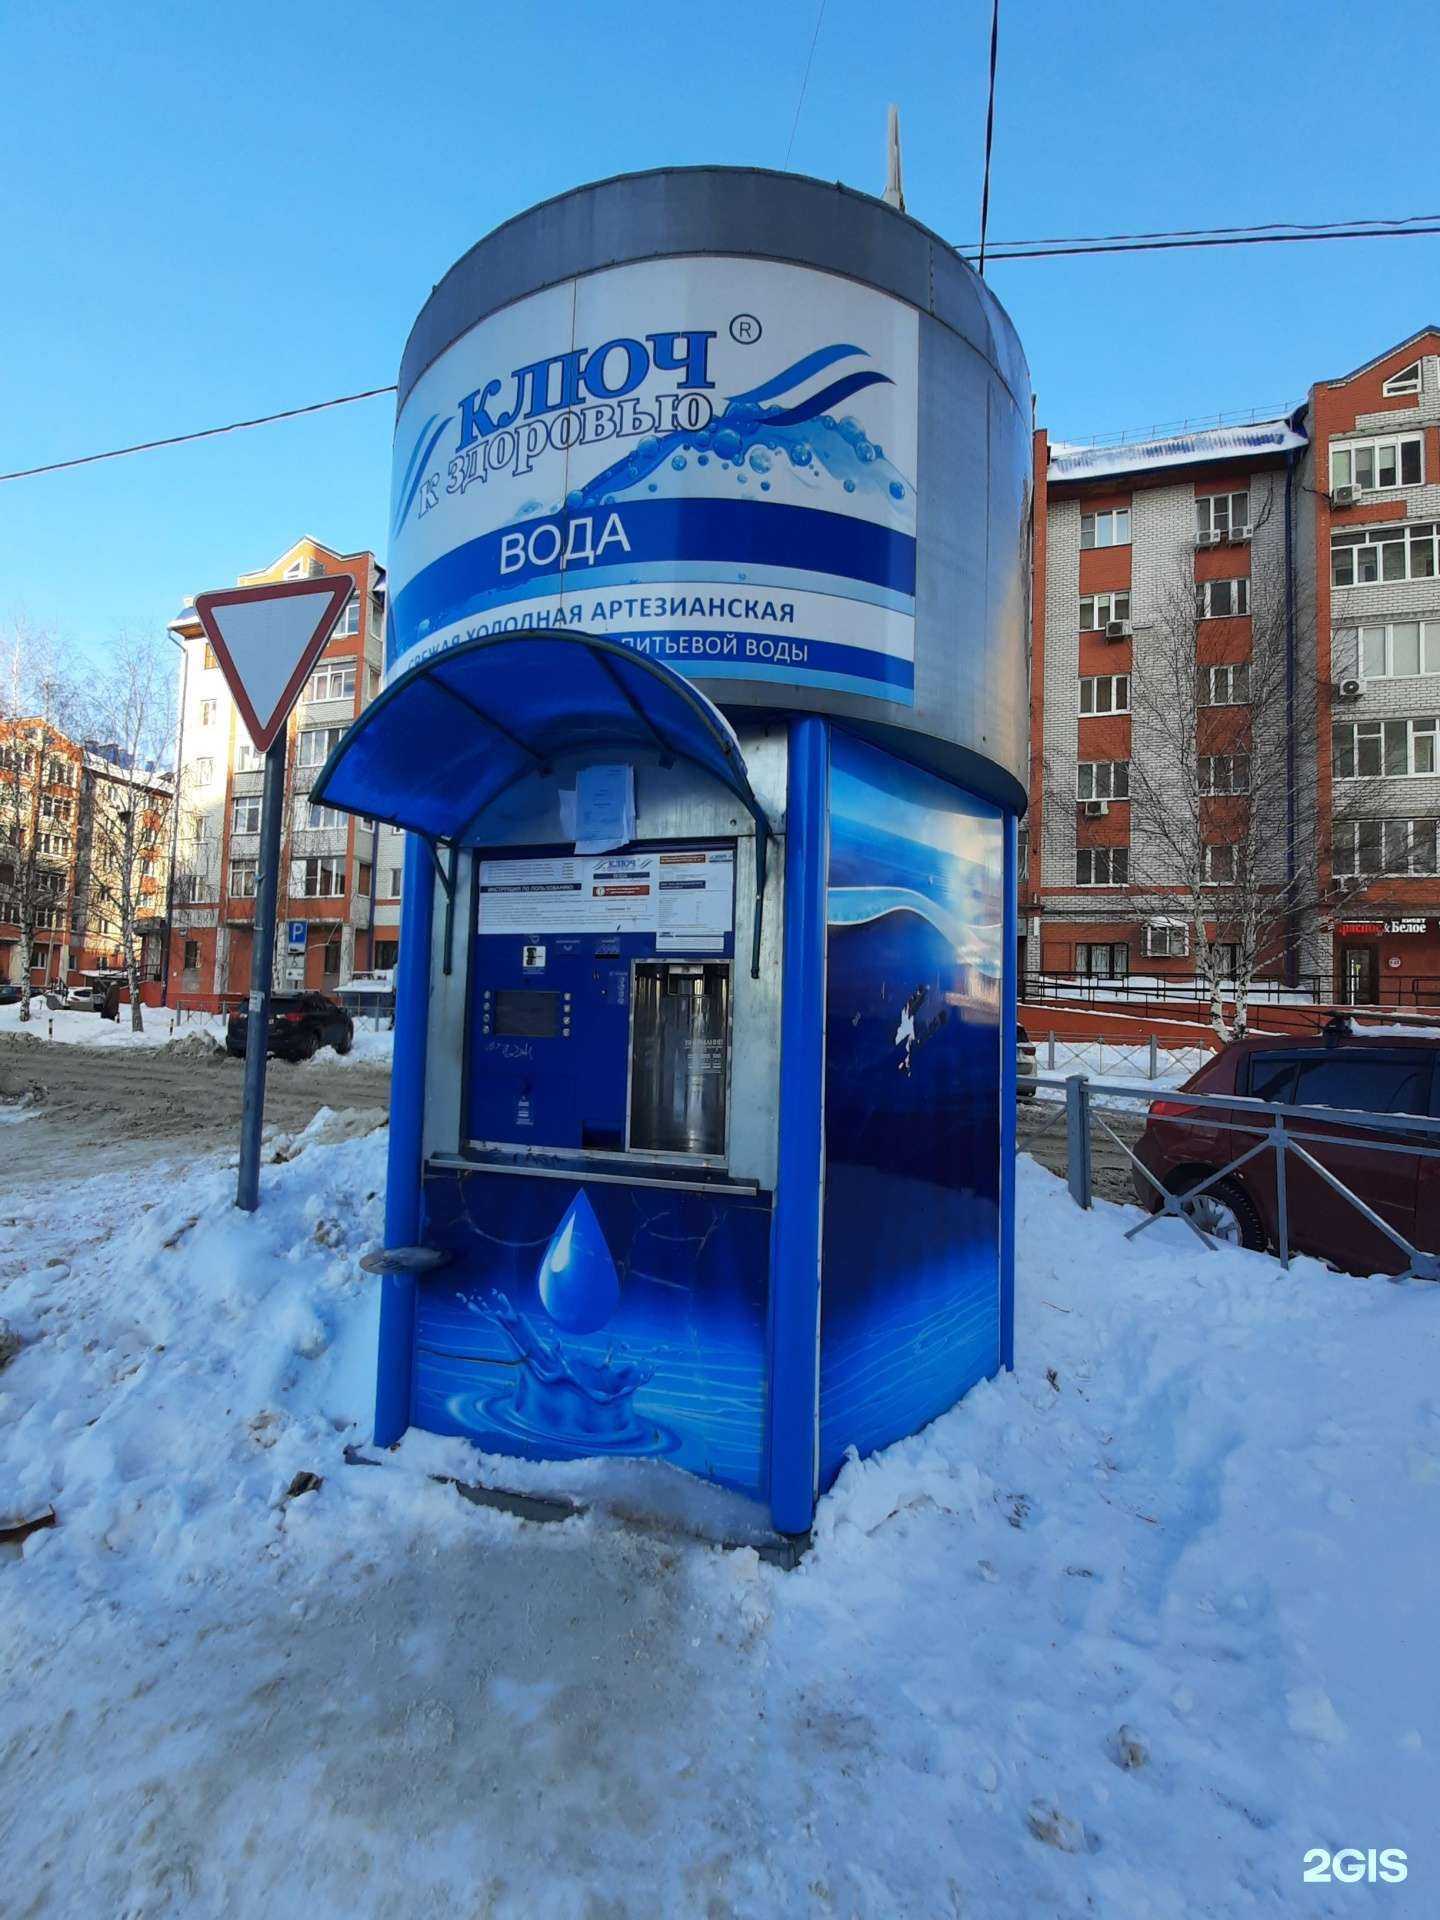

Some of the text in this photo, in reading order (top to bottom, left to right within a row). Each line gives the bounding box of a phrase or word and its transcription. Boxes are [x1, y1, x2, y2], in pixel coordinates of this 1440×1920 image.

[499, 513, 631, 575] ВОДА
[590, 597, 795, 623] АРТЕЗИАНСКАЯ
[746, 638, 808, 663] ВОДЫ
[1391, 920, 1427, 933] Белое
